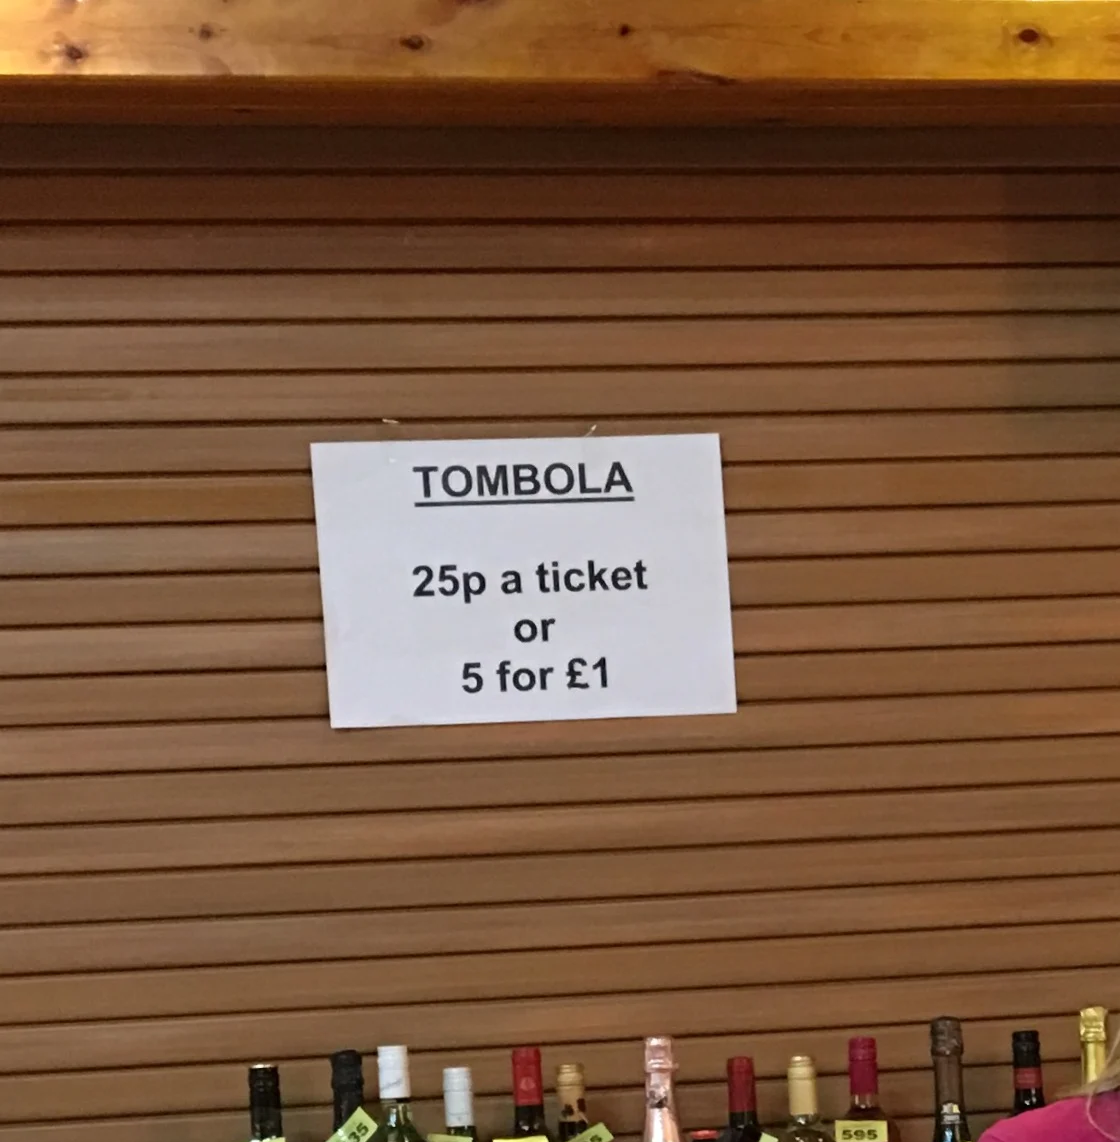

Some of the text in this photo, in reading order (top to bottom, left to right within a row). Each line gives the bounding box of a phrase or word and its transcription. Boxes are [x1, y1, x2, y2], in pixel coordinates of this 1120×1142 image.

[412, 461, 634, 499] TOMBOLA
[411, 559, 648, 604] 25p a ticket
[513, 617, 556, 643] or
[461, 656, 609, 694] 5 for £1
[841, 1128, 879, 1142] 595
